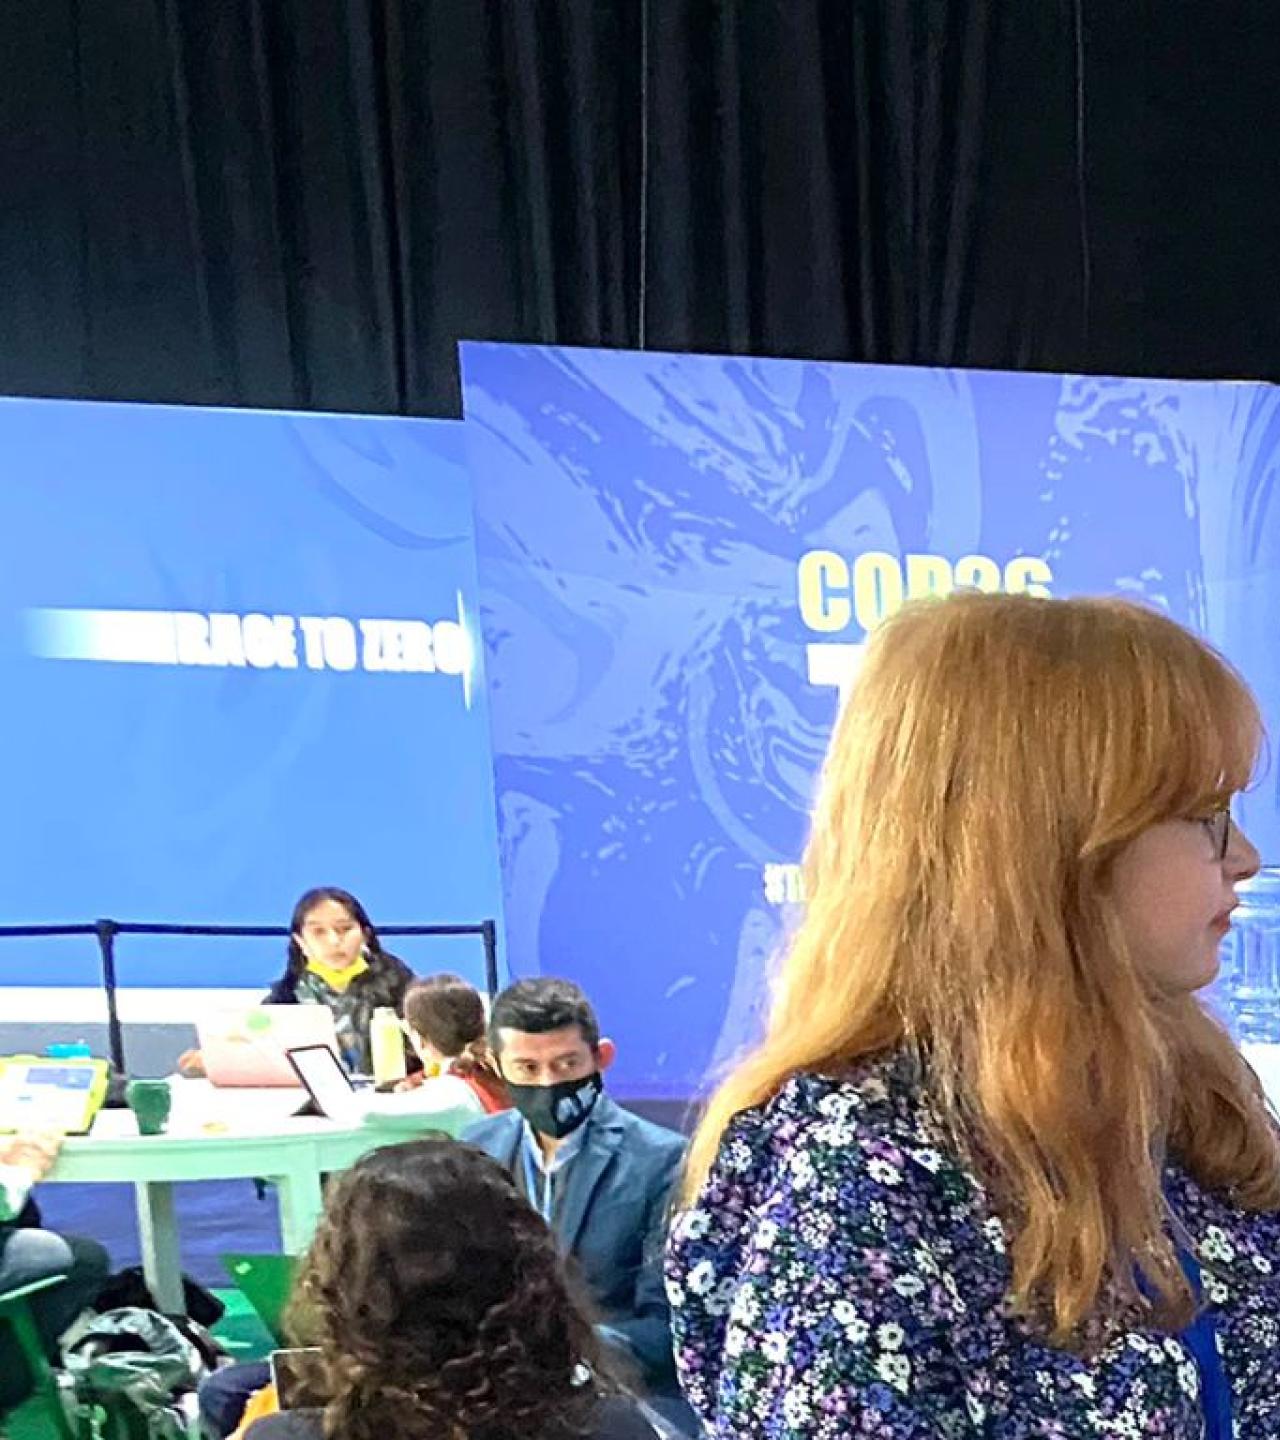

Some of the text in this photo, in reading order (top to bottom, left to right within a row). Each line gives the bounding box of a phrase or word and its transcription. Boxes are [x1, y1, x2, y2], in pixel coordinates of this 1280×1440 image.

[175, 611, 470, 675] RACE TO ZERO
